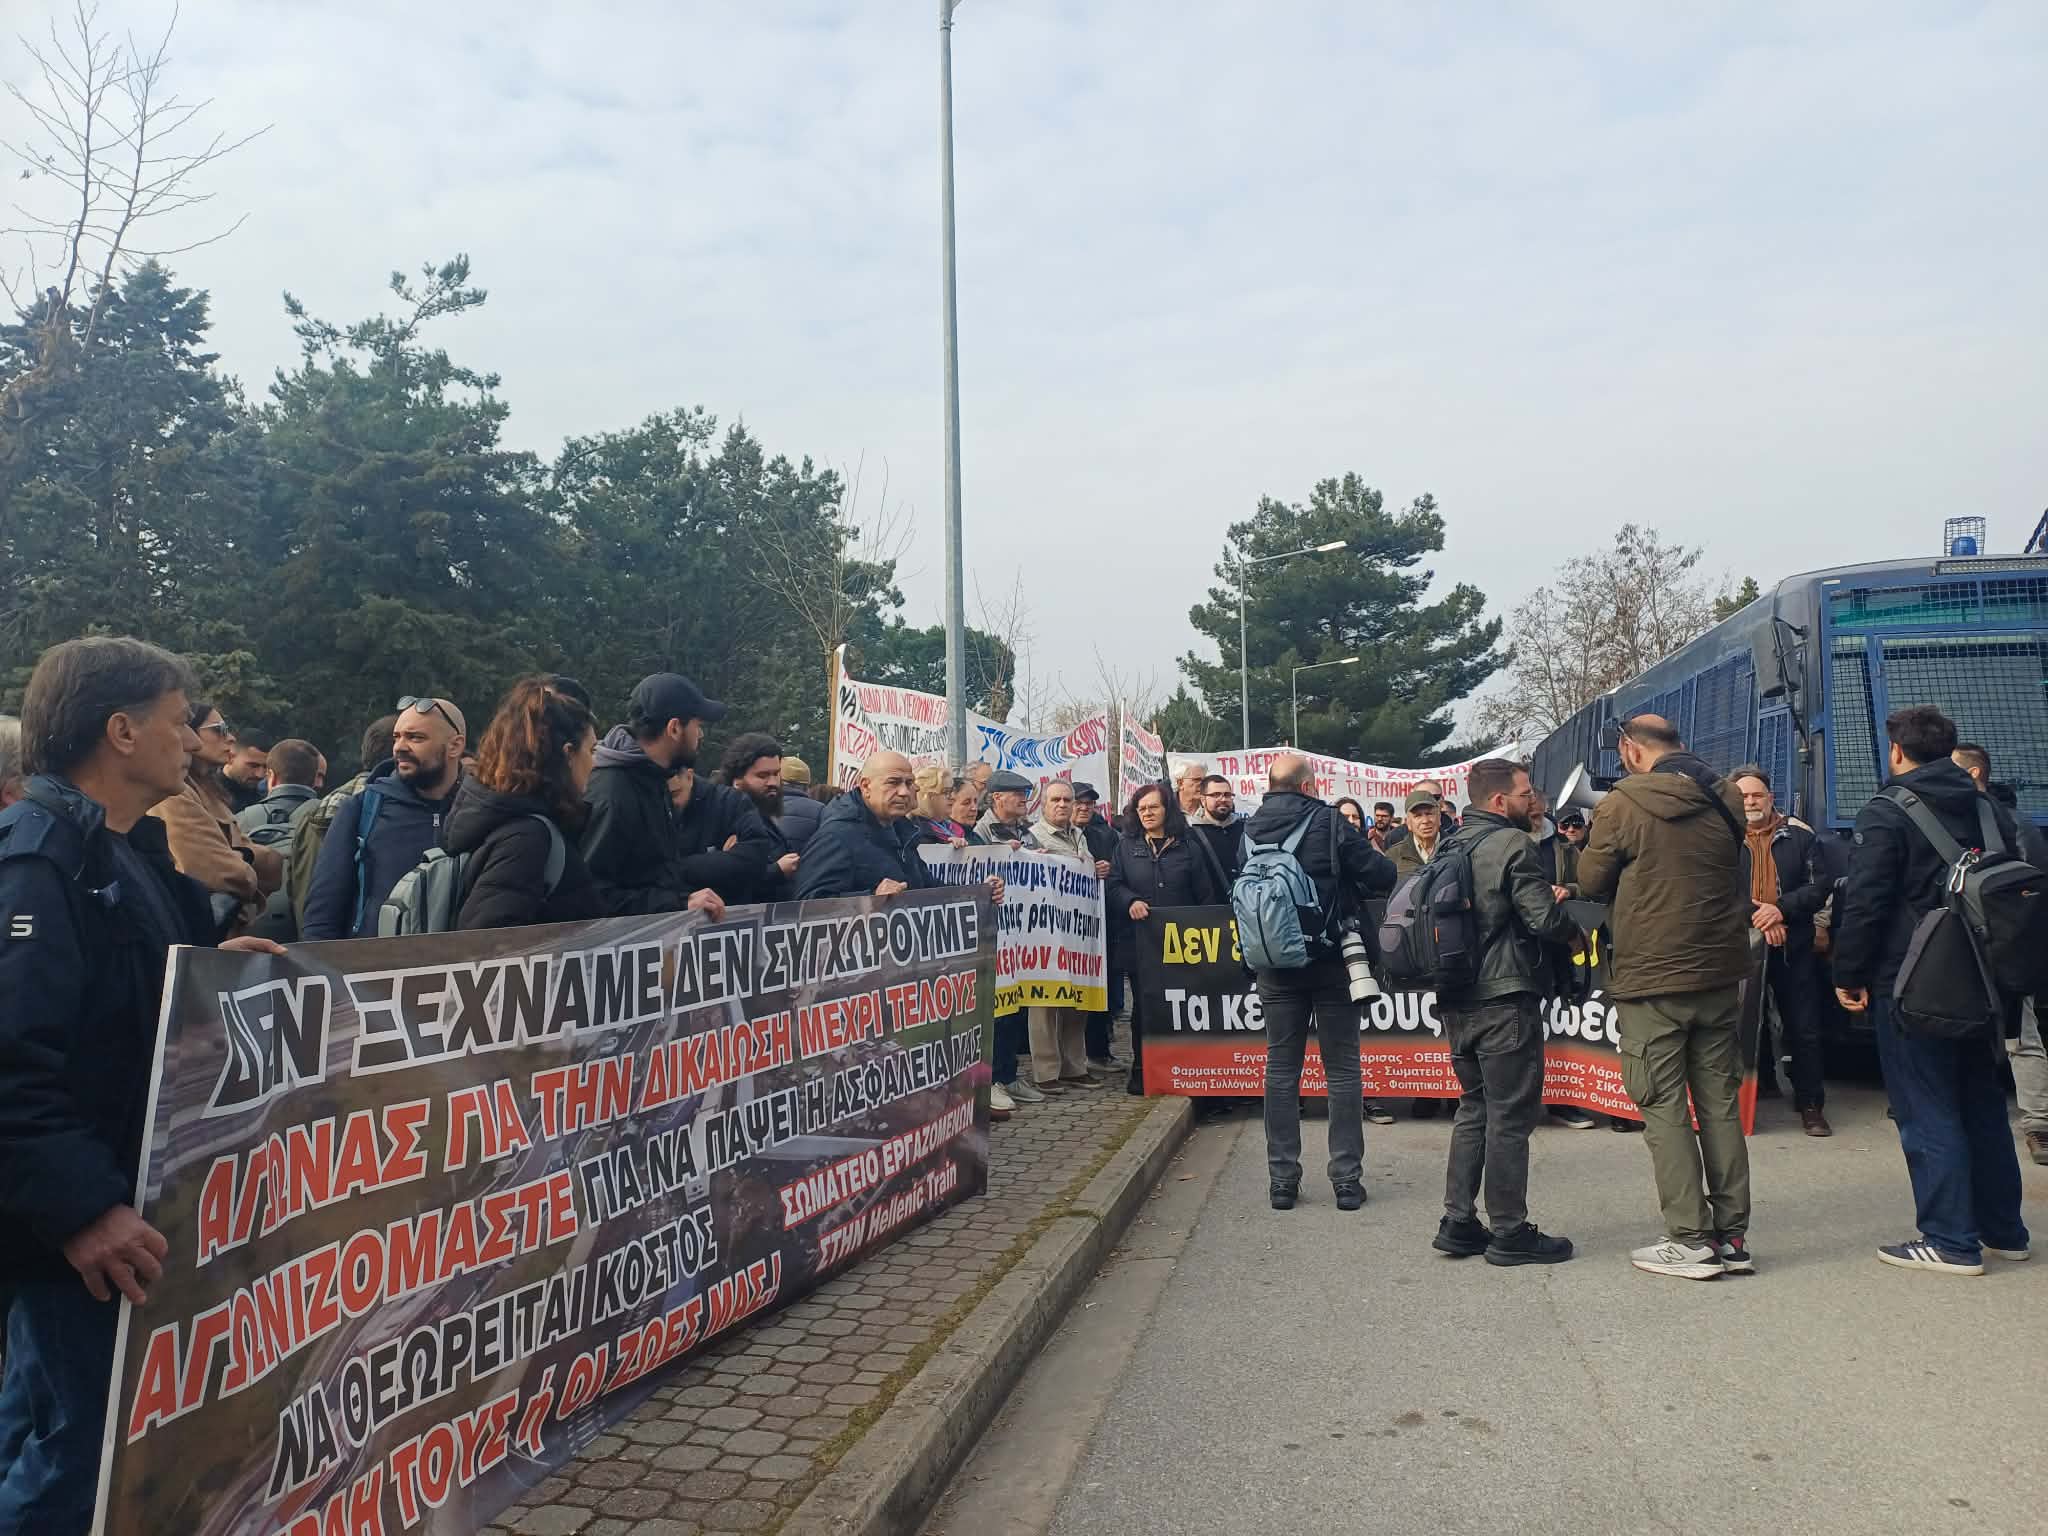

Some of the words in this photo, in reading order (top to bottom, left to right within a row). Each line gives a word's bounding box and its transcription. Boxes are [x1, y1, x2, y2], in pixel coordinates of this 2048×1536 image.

[1216, 757, 1240, 776] ΤΑ
[1345, 779, 1361, 796] ΤΟ
[1366, 781, 1417, 798] ΕΓΚΛΗΜ
[1441, 778, 1458, 797] ΤΑ
[1163, 922, 1220, 965] Δεν
[343, 940, 664, 1078] ΞΕΧΝΑΜΕ
[671, 922, 754, 1016] ΔΕΝ
[760, 900, 979, 995] ΣΥΓΧΩΡΟΥΜΕ
[1165, 989, 1210, 1031] Τα
[1222, 982, 1266, 1031] κέ
[1171, 1065, 1259, 1078] Φαρμακευτικός
[1233, 1052, 1268, 1064] Εργατ
[1360, 1053, 1402, 1064] άρισας
[1384, 1066, 1443, 1078] Σωματείο
[1171, 1079, 1208, 1092] Ένωση
[1210, 1079, 1259, 1092] Συλλόγων
[1389, 1079, 1443, 1092] Φοιτητικοί
[1544, 1072, 1585, 1088] άρισας
[197, 1097, 430, 1269] ΑΓΩΝΑΣ
[443, 1078, 532, 1172] ΓΙΑ
[531, 1050, 634, 1142] ΤΗΝ
[640, 1012, 792, 1112] ΔΙΚΑΙΩΣΗ
[799, 987, 884, 1061] ΜΕΧΡΙ
[886, 969, 978, 1033] ΤΕΛΟΥΣ
[780, 1150, 879, 1227] ΣΩΜΑΤΕΙΟ
[881, 1101, 975, 1178] ΕΡΓΑΖΟΜΕΝΩΝ
[127, 1168, 578, 1445] ΑΓΩΝΙΖΟΜΑΣΤΕ
[579, 1145, 645, 1229] ΓΙΑ
[645, 1119, 699, 1201] ΝΑ
[705, 1088, 800, 1175] ΠΑΨΕΙ
[806, 1074, 828, 1134] Η
[831, 1043, 951, 1123] ΑΣΦΑΛΕΙΑ
[951, 1025, 983, 1078] ΜΑΣ
[815, 1215, 866, 1273] ΣΤΗΝ
[866, 1180, 925, 1242] Hellenic
[926, 1160, 957, 1203] Train
[264, 1382, 342, 1507] ΝΑ
[340, 1264, 588, 1449] ΘΕΩΡΕΙΤΑΙ
[592, 1204, 717, 1325] ΚΟΣΤΟΣ
[390, 1388, 520, 1530] ΤΟΥΣ
[515, 1364, 557, 1458] ή
[557, 1342, 609, 1421] ΟΙ
[602, 1293, 702, 1396] ΖΩΕΣ
